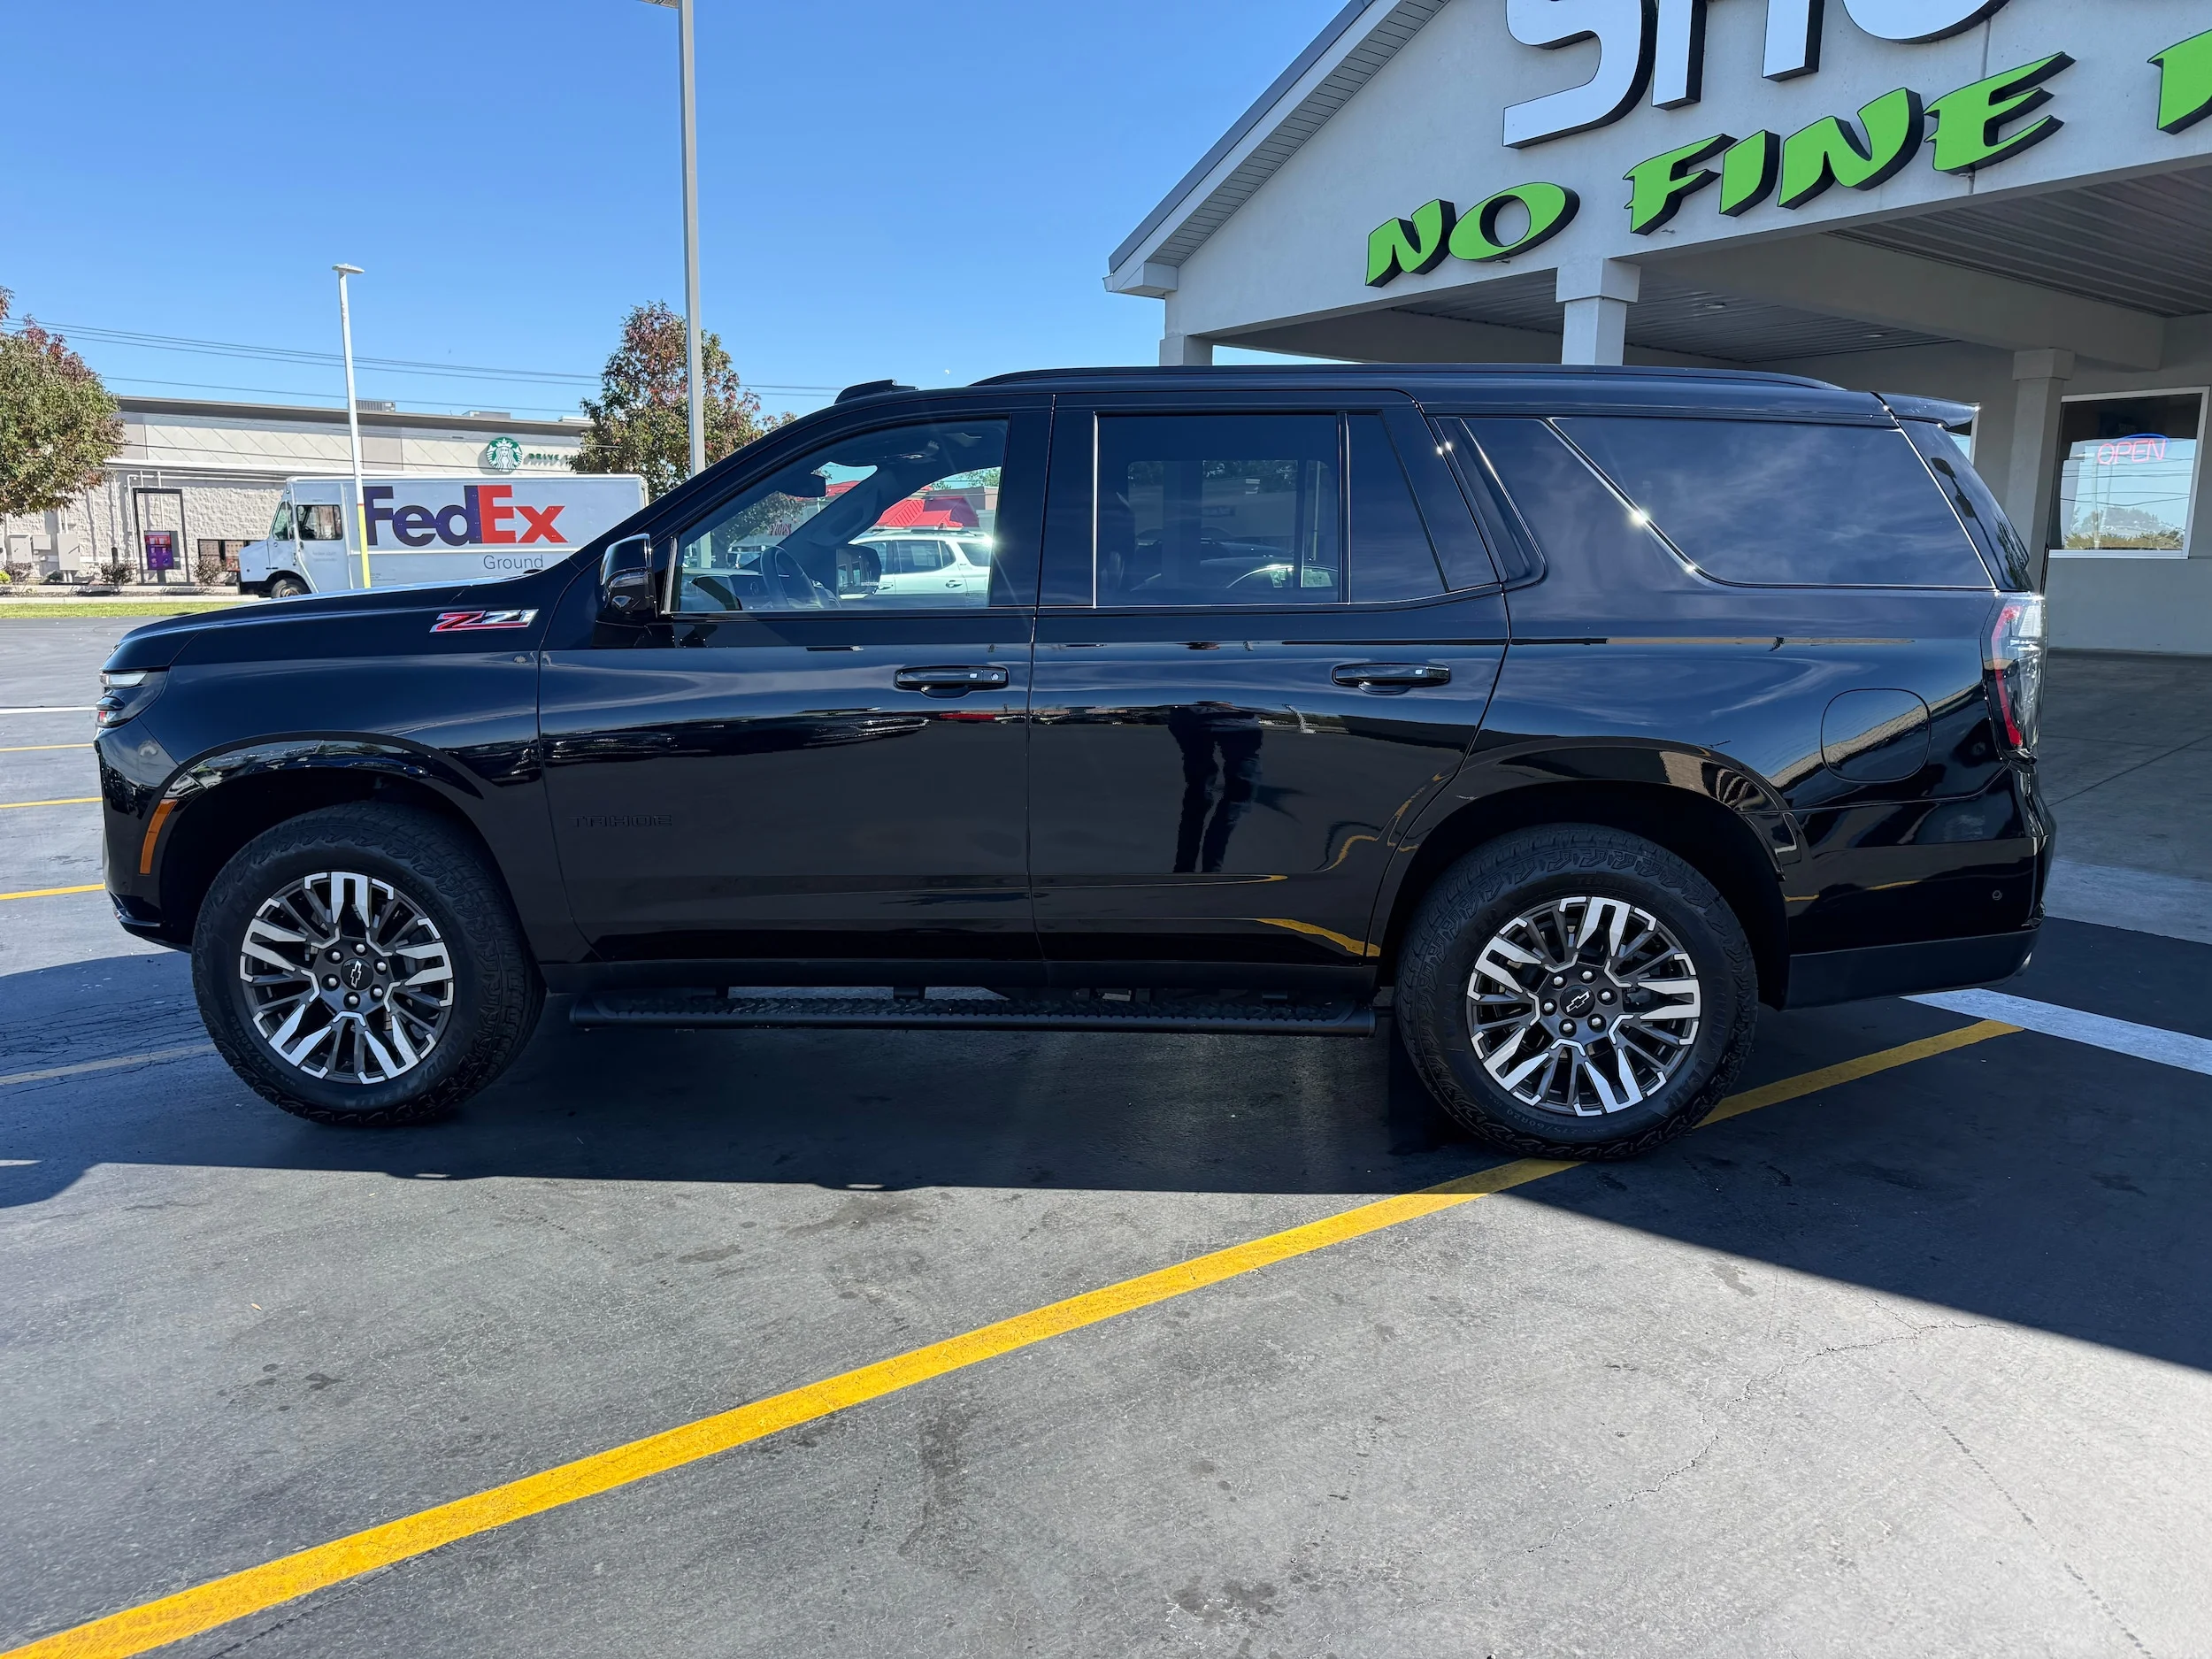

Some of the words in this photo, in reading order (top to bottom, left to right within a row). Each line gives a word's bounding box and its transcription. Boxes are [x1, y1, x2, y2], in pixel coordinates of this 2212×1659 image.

[1365, 181, 1579, 288] NO
[1624, 51, 2076, 234] FINE
[2097, 439, 2166, 465] OPEN
[363, 485, 569, 548] FedEx
[483, 555, 544, 570] Ground
[429, 609, 539, 633] Z71
[566, 814, 672, 828] TAHOE
